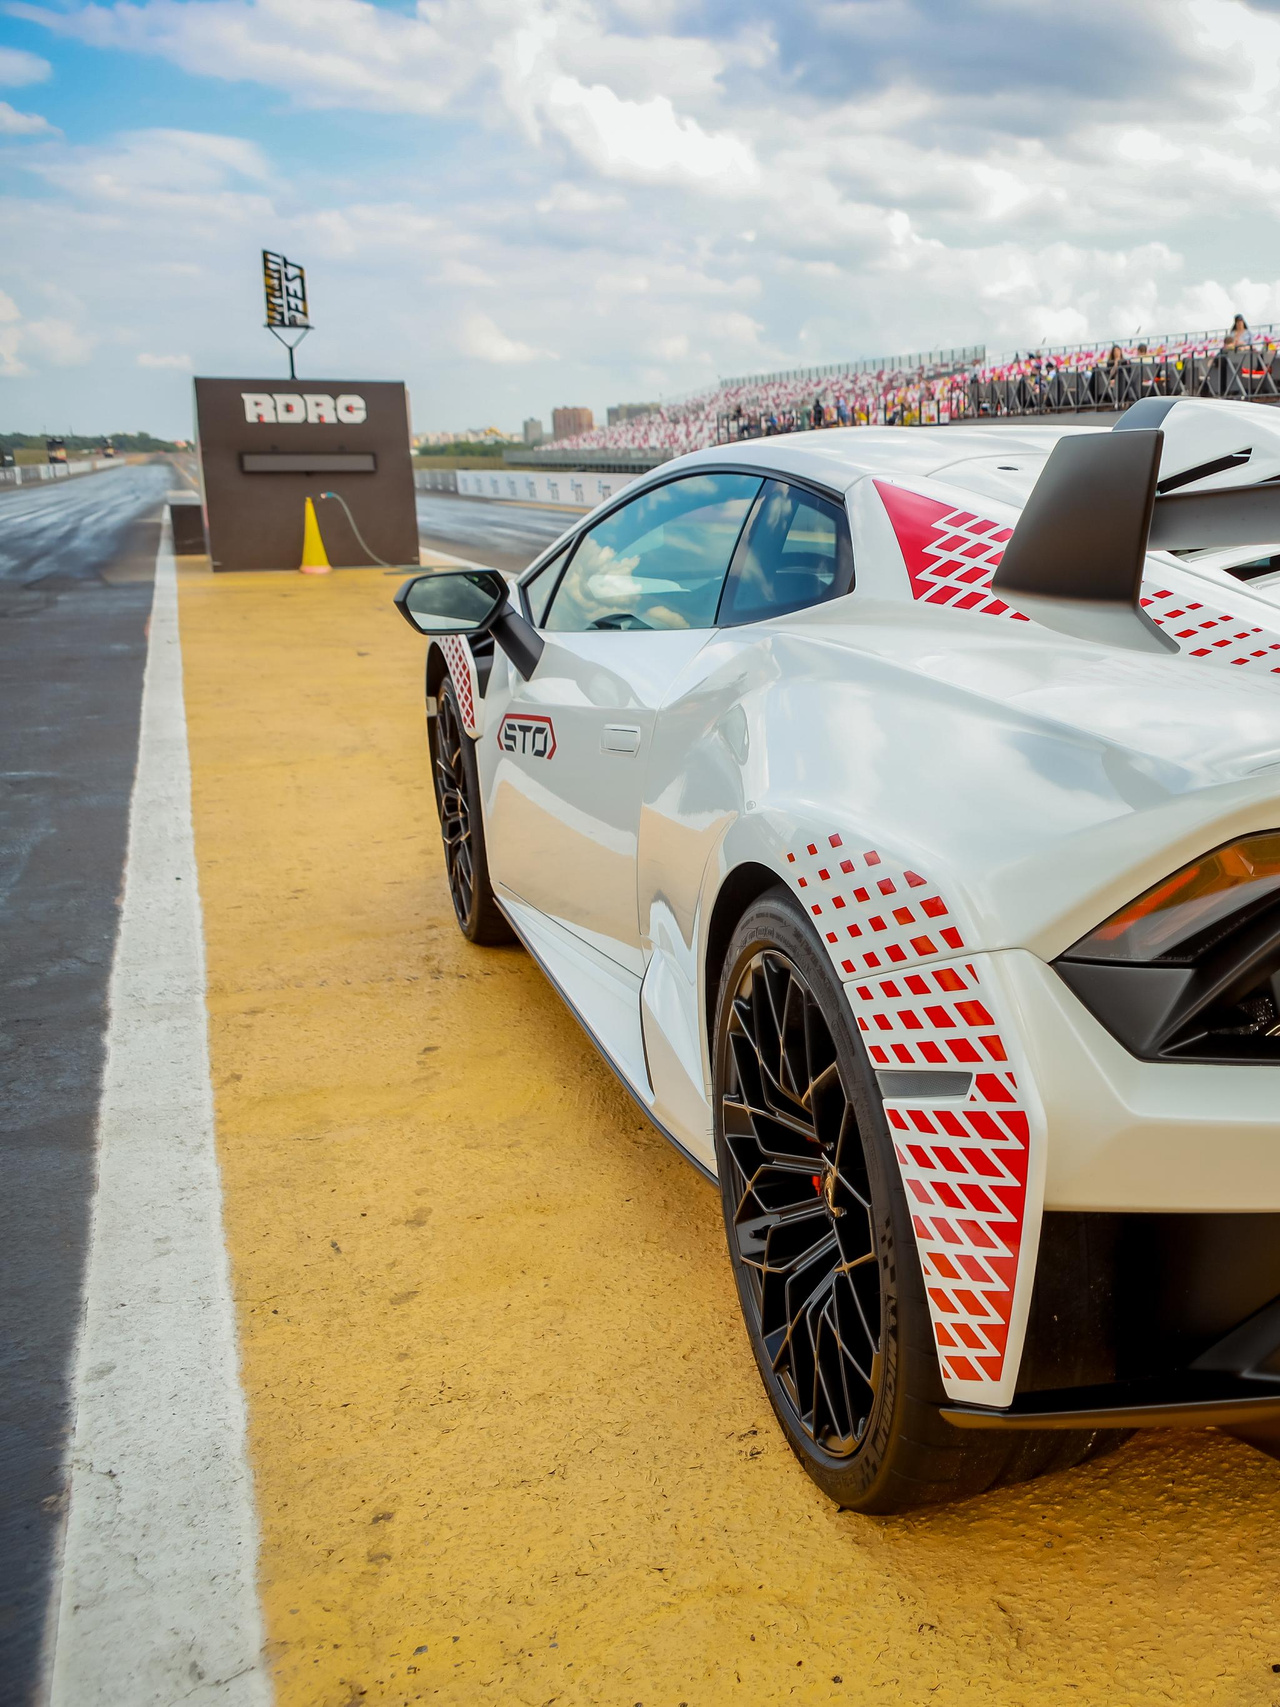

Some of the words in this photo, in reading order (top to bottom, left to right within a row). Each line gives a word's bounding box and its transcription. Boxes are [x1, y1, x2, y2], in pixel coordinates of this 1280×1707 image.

[241, 393, 367, 424] RDRC
[504, 723, 548, 757] STO
[873, 1331, 898, 1460] MICHELIN
